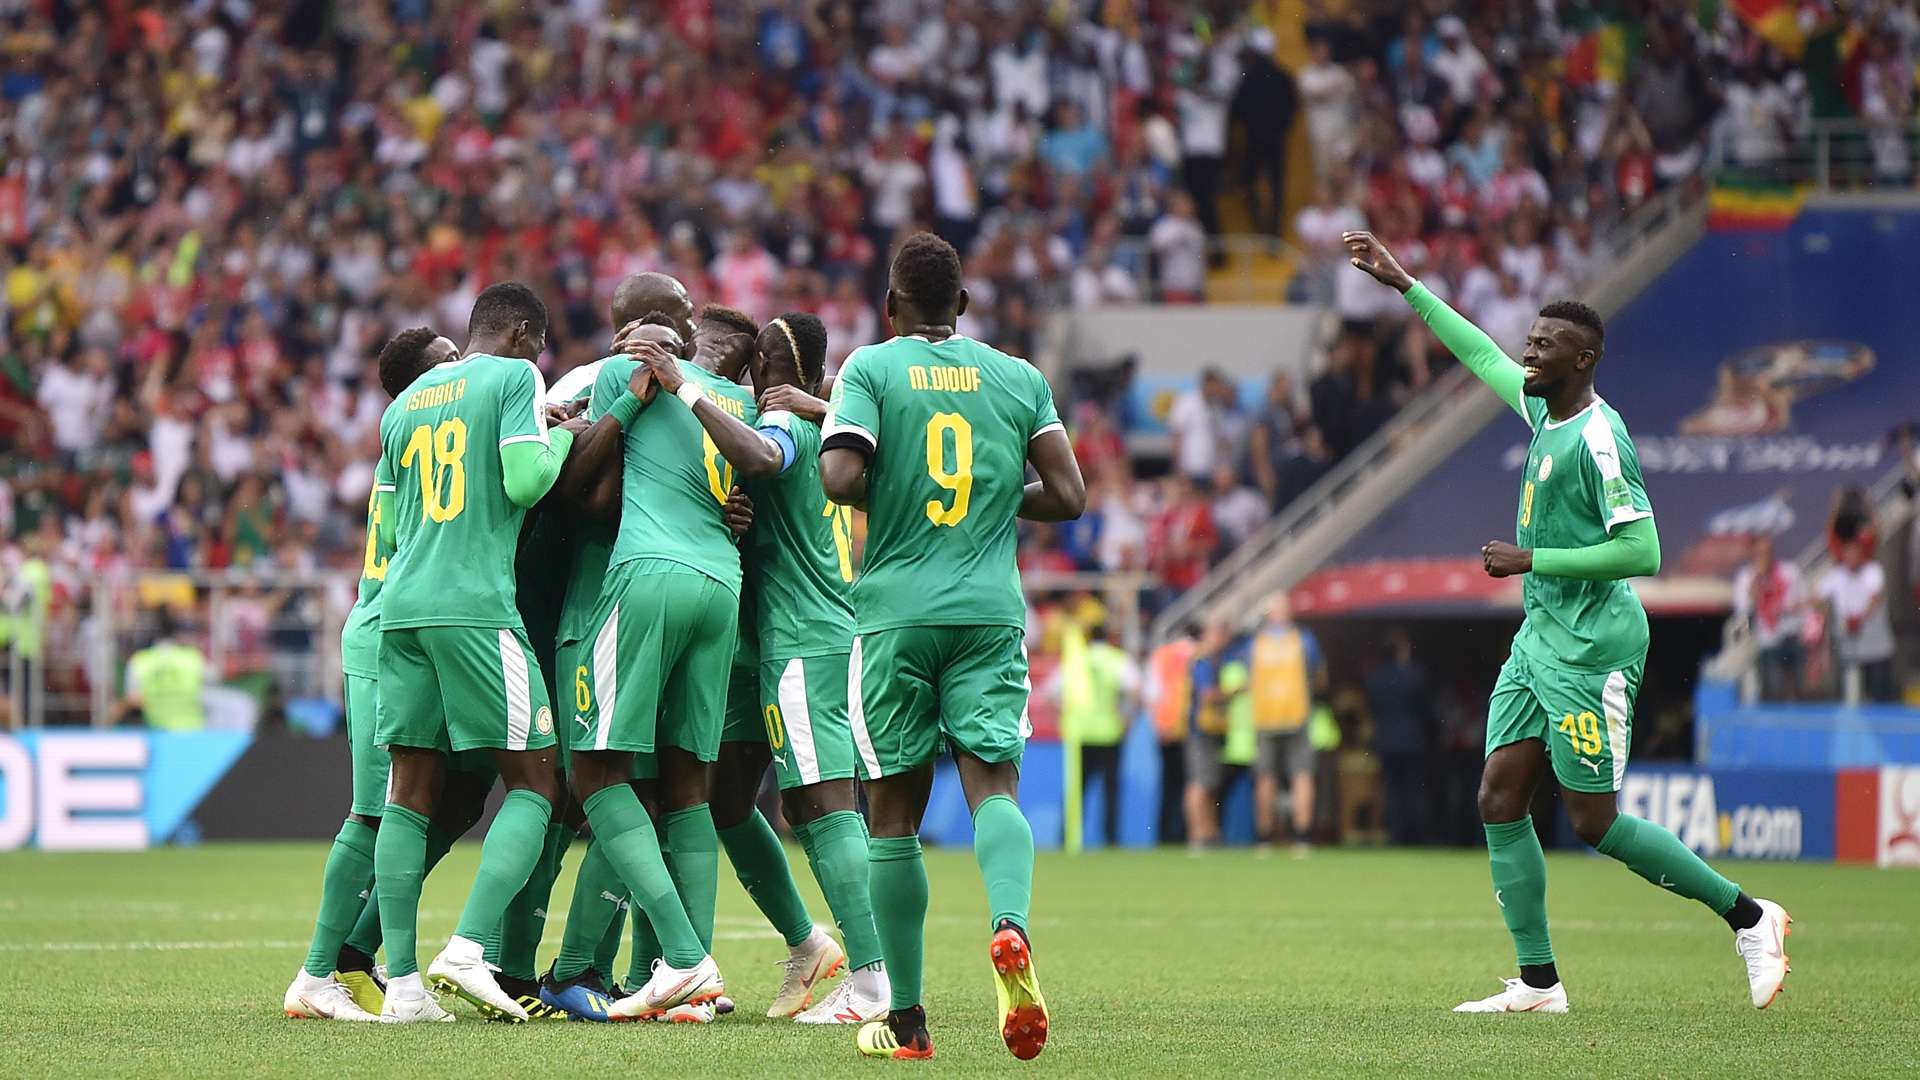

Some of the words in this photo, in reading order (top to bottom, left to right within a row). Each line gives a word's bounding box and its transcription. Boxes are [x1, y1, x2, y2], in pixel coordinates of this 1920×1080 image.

[406, 378, 467, 412] ISMAILA
[908, 366, 982, 393] M.DIOUF
[401, 417, 467, 527] 18
[926, 412, 974, 528] 9
[575, 665, 591, 712] 6
[1559, 711, 1603, 757] 19
